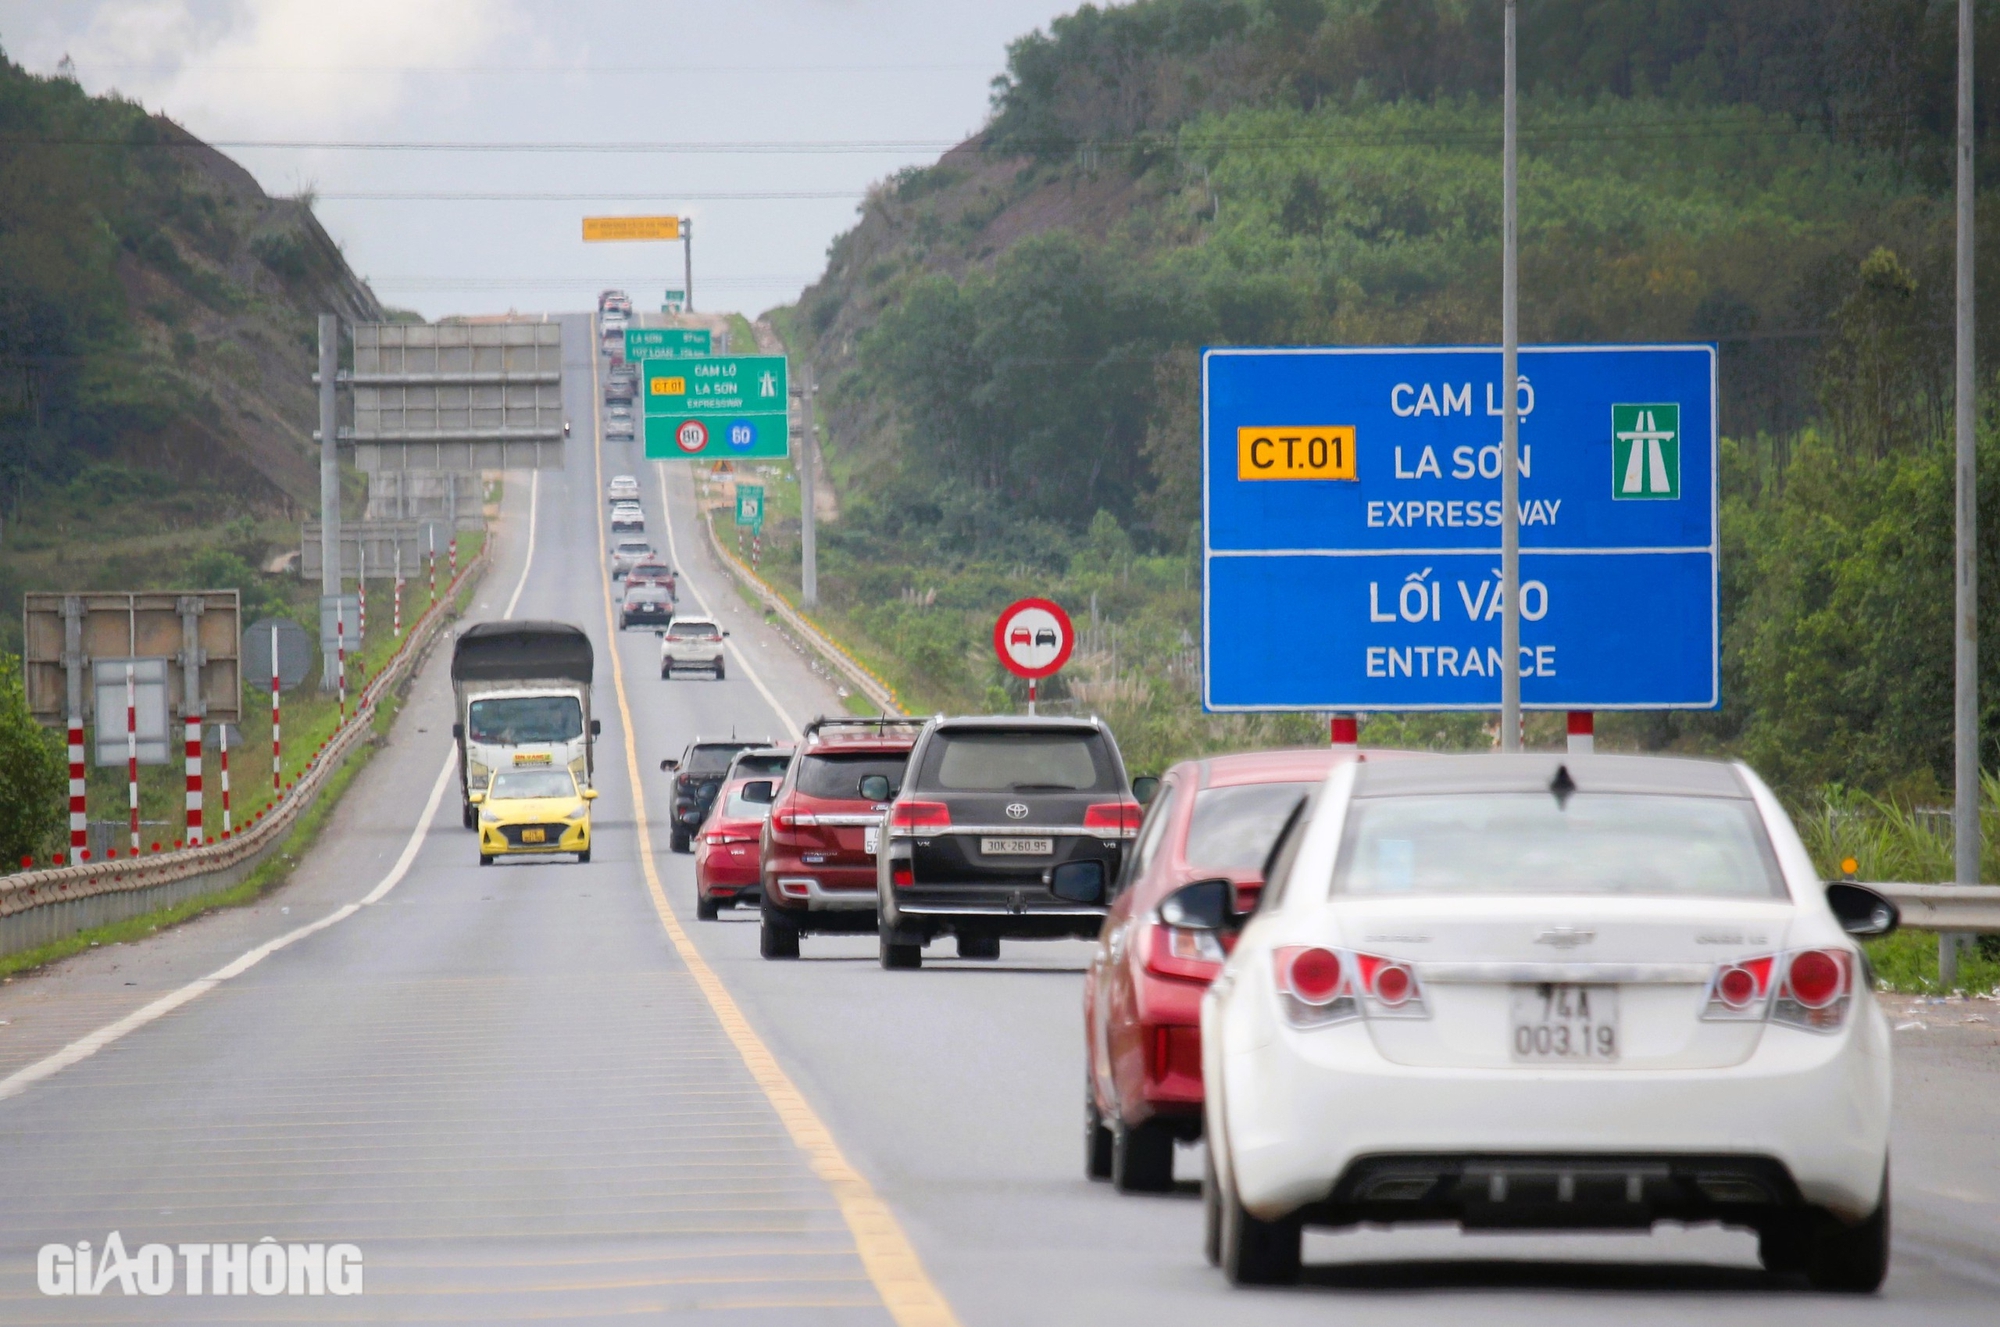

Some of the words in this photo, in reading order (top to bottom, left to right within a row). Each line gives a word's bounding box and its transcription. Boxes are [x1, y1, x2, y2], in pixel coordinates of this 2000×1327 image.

[695, 364, 720, 377] CAM
[722, 363, 737, 378] LỘ
[654, 381, 682, 393] CT.01
[695, 383, 711, 395] LA
[714, 382, 738, 395] SƠN
[1391, 381, 1472, 418] CAM
[1486, 374, 1535, 424] LỘ
[686, 398, 743, 409] EXPRESSWAY
[682, 426, 699, 443] 80
[732, 426, 751, 444] 60
[1250, 437, 1344, 470] CT.01
[1394, 445, 1442, 480] LA
[1369, 567, 1440, 623] LỐI
[1457, 567, 1549, 622] VÀO
[1366, 645, 1556, 679] ENTRANCE
[1515, 1025, 1615, 1057] 003.19
